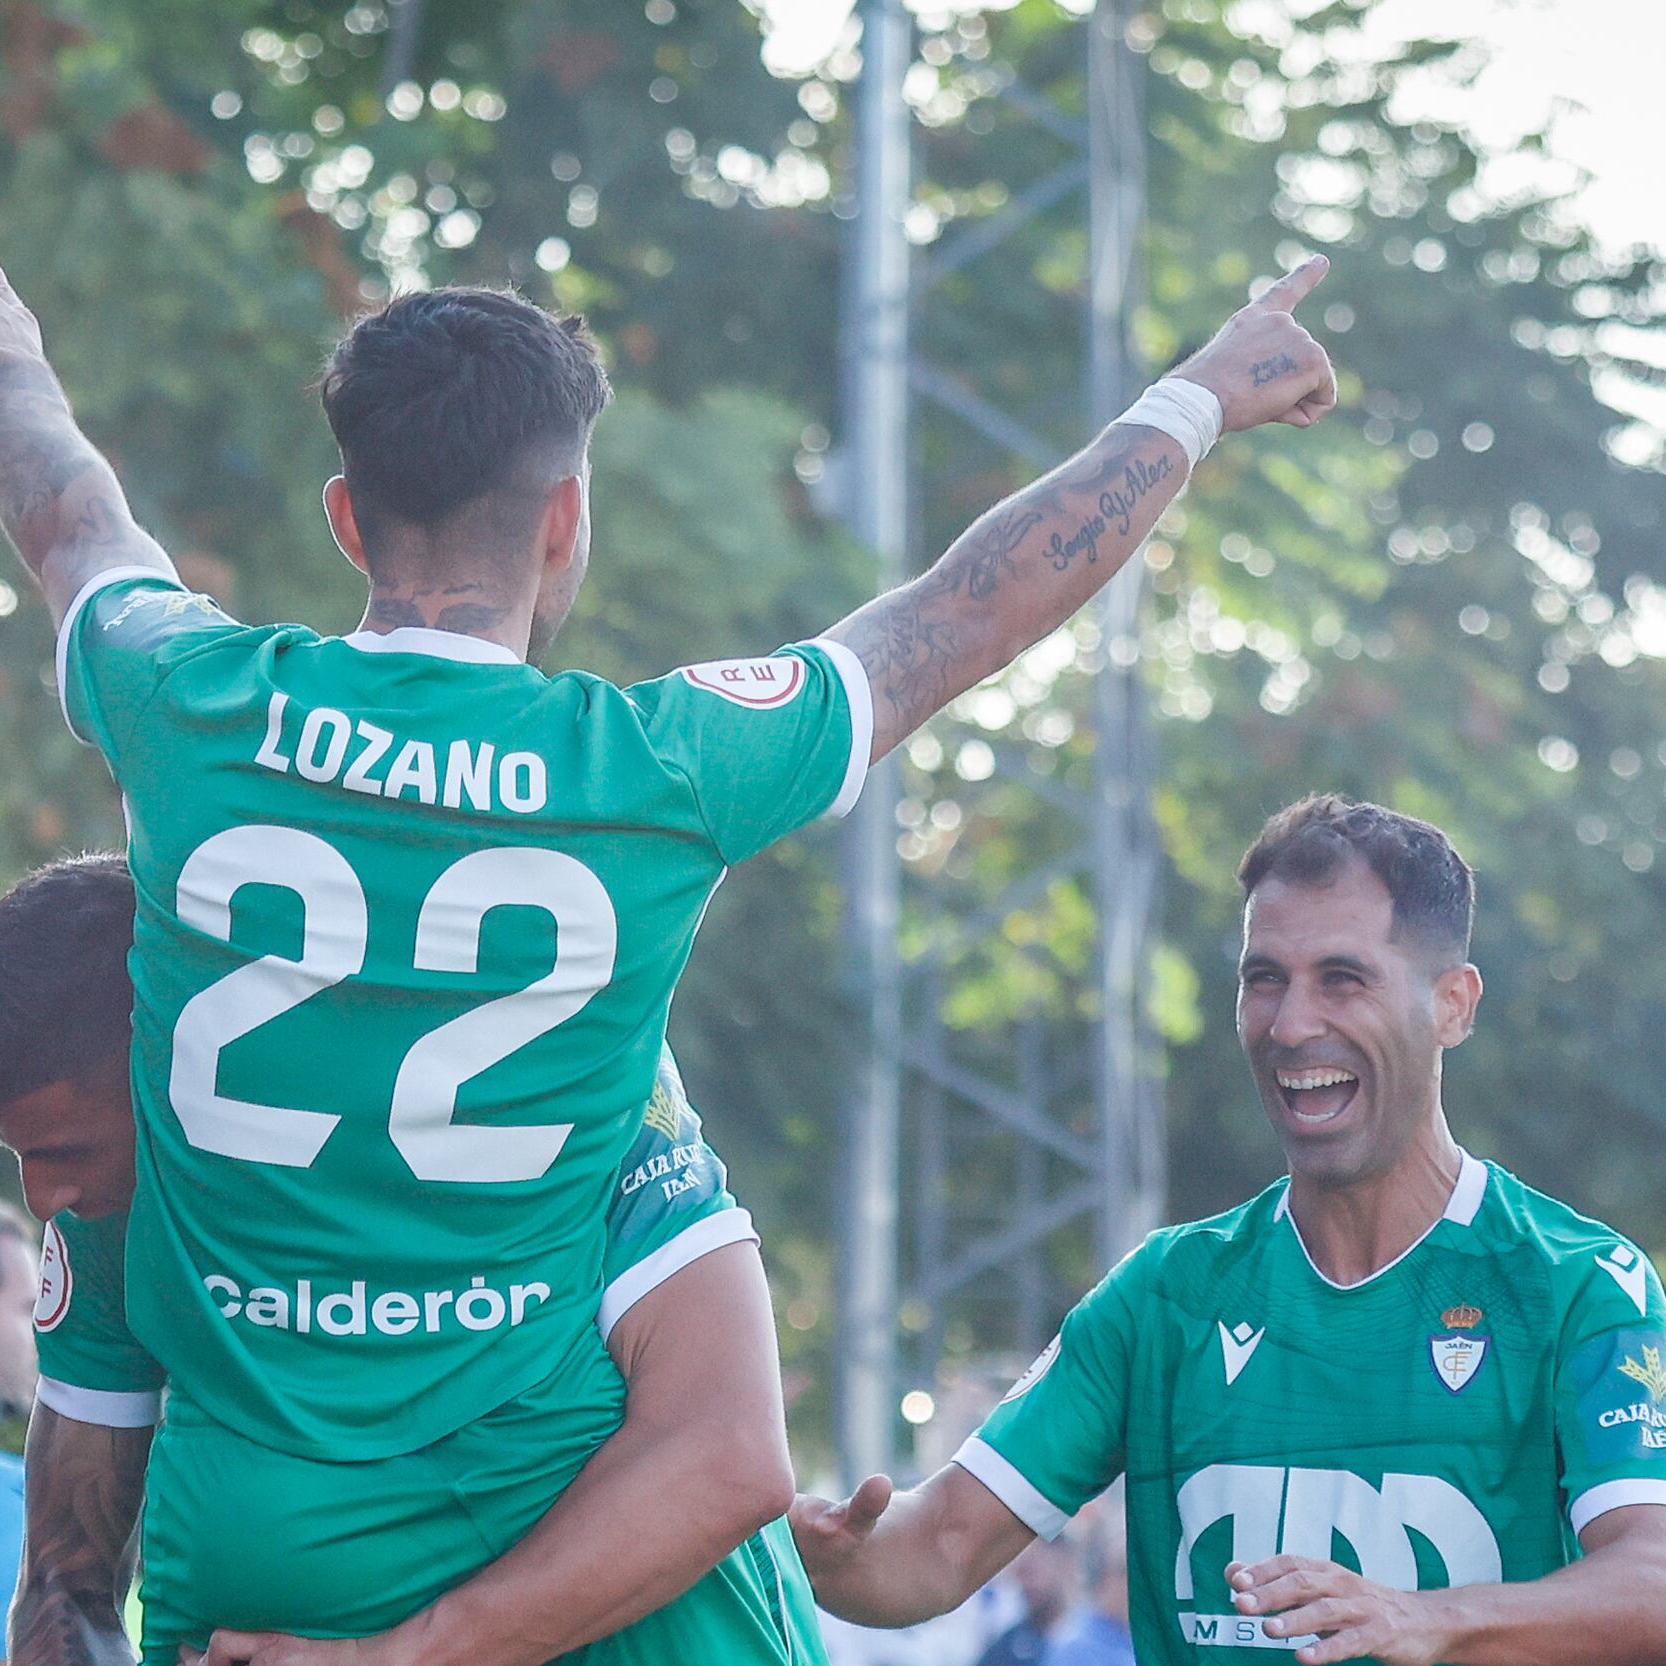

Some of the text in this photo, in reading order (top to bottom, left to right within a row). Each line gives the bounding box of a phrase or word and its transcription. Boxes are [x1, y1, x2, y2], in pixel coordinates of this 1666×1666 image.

[253, 691, 547, 814] LOZANO
[168, 824, 618, 1183] 22
[1598, 1402, 1652, 1428] CAJA
